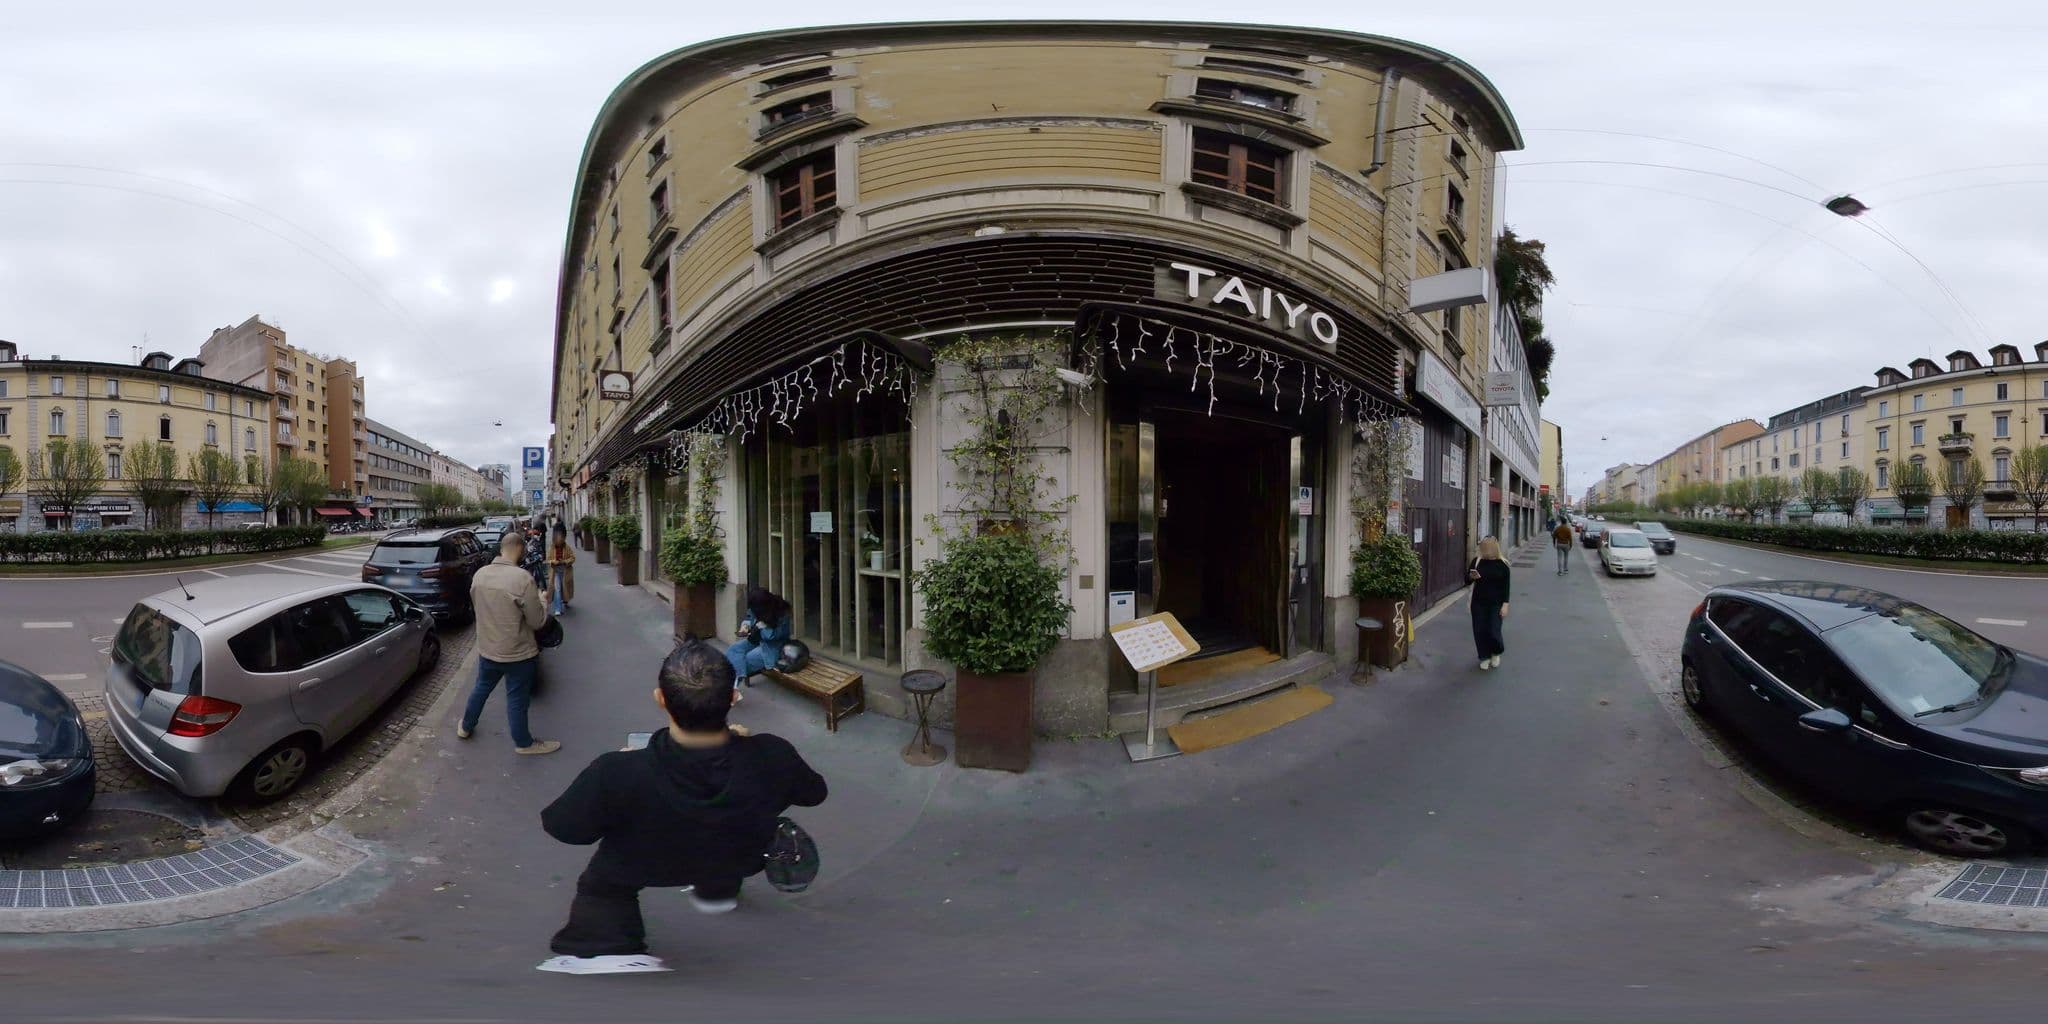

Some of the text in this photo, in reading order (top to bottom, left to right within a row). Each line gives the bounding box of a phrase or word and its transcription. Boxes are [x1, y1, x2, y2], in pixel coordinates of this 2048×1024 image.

[1171, 262, 1338, 344] TAIYO
[604, 391, 630, 400] TAIYO
[527, 448, 541, 467] P
